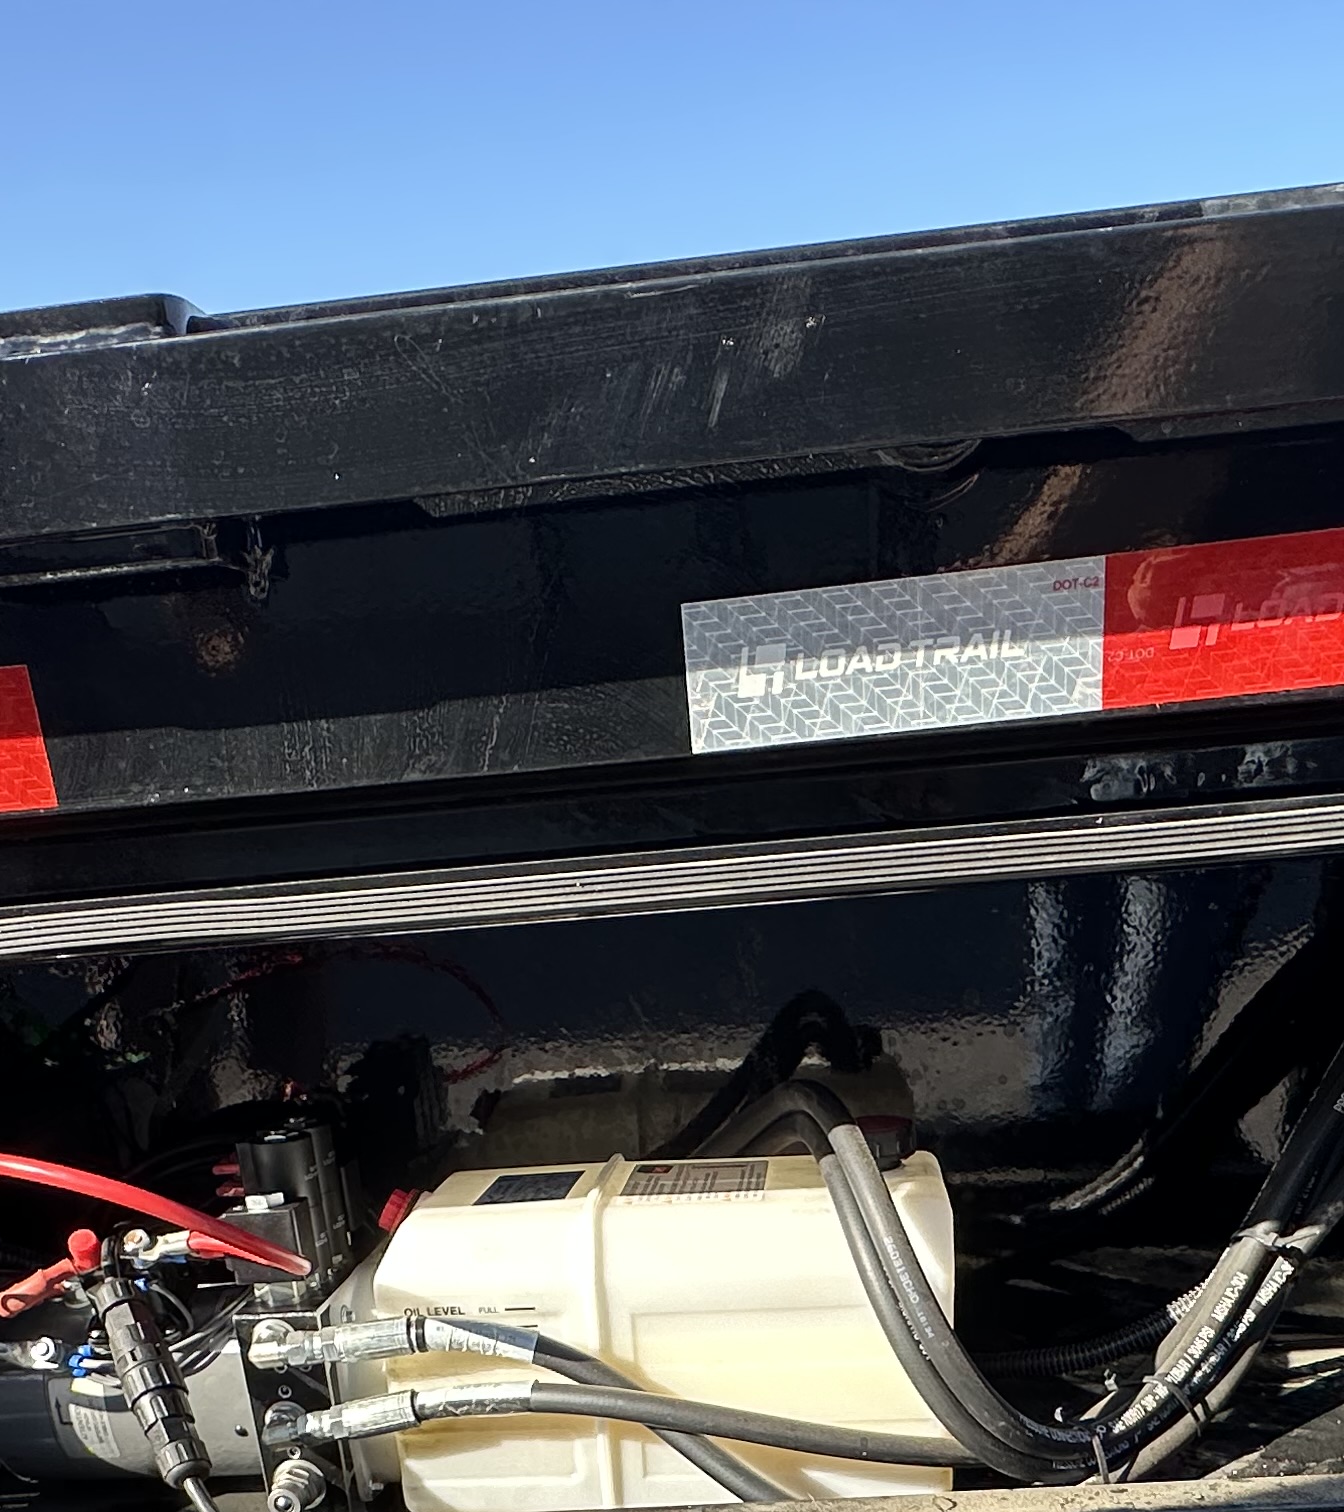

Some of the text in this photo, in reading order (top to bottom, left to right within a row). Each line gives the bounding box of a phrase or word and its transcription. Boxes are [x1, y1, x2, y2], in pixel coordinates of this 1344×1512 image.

[1052, 576, 1099, 591] DOT-C2
[794, 642, 902, 681] LOAD
[910, 630, 1026, 668] TRAIL
[404, 1308, 423, 1317] OIL
[426, 1306, 465, 1316] LEVEL
